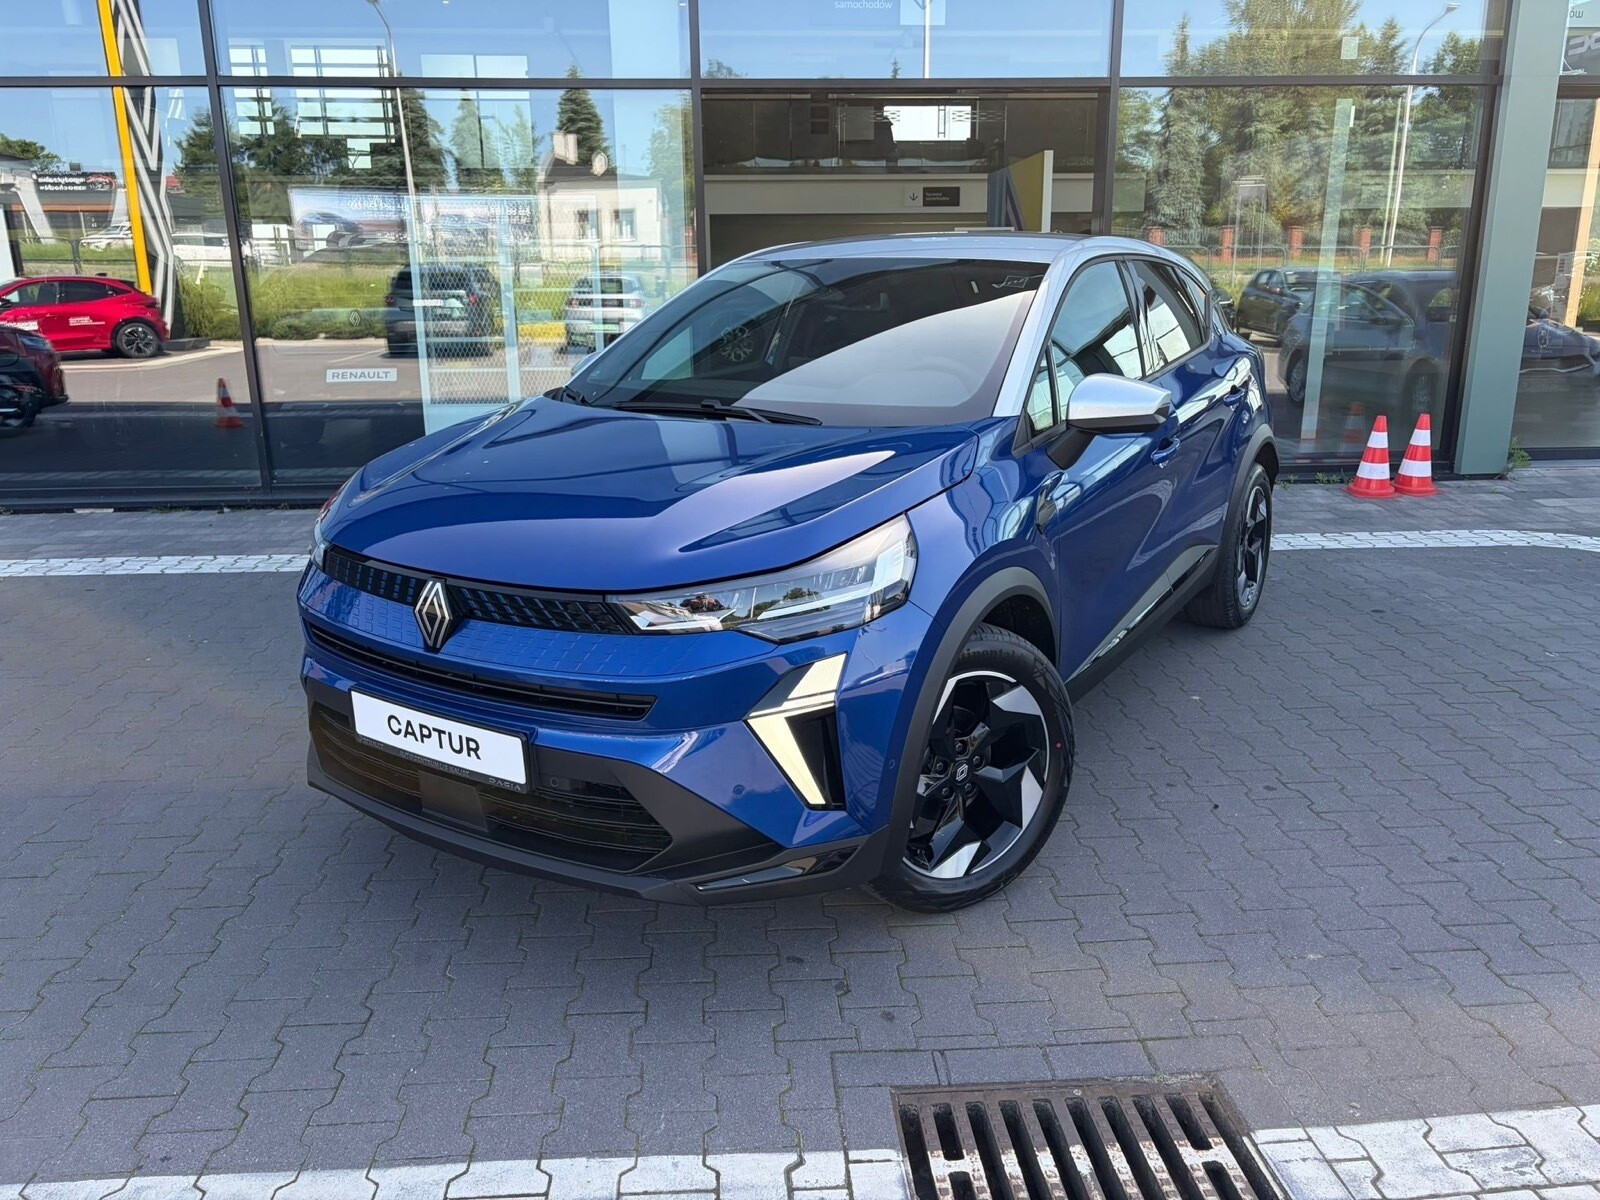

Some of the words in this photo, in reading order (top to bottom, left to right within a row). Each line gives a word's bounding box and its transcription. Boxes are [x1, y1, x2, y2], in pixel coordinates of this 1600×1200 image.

[834, 0, 893, 9] samochodów
[331, 371, 390, 380] RENAULT
[387, 714, 482, 760] CAPTUR
[488, 777, 522, 791] DACIA
